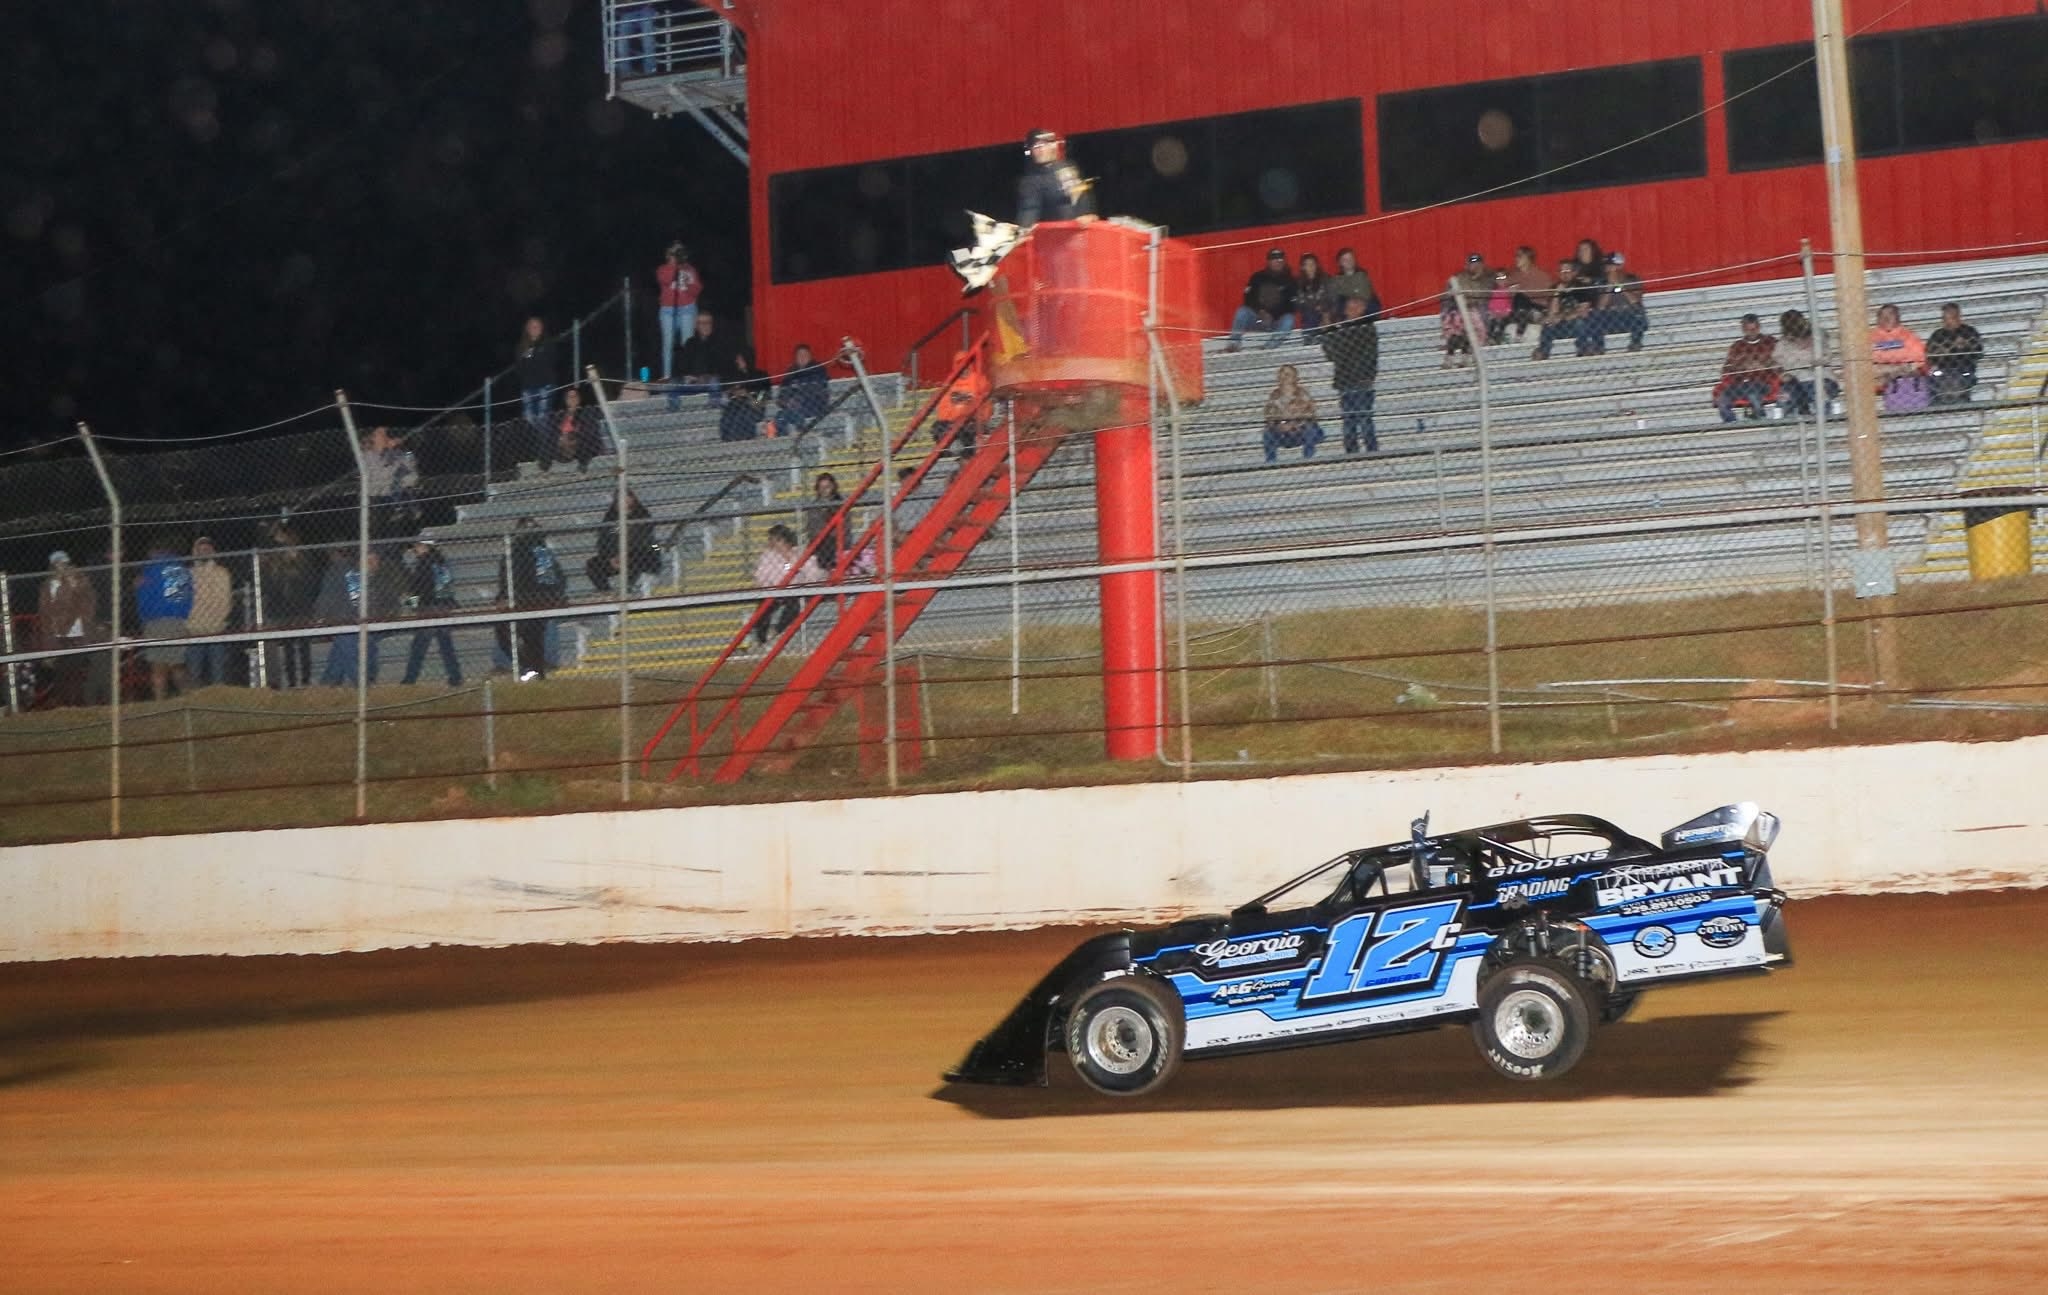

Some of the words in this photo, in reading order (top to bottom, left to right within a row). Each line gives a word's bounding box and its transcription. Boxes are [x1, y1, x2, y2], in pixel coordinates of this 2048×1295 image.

[1487, 849, 1609, 878] GIDDENS
[1496, 877, 1571, 903] GRADING
[1598, 867, 1743, 907] BRYANT
[1697, 922, 1746, 935] COLONY
[1195, 931, 1304, 967] Georgia
